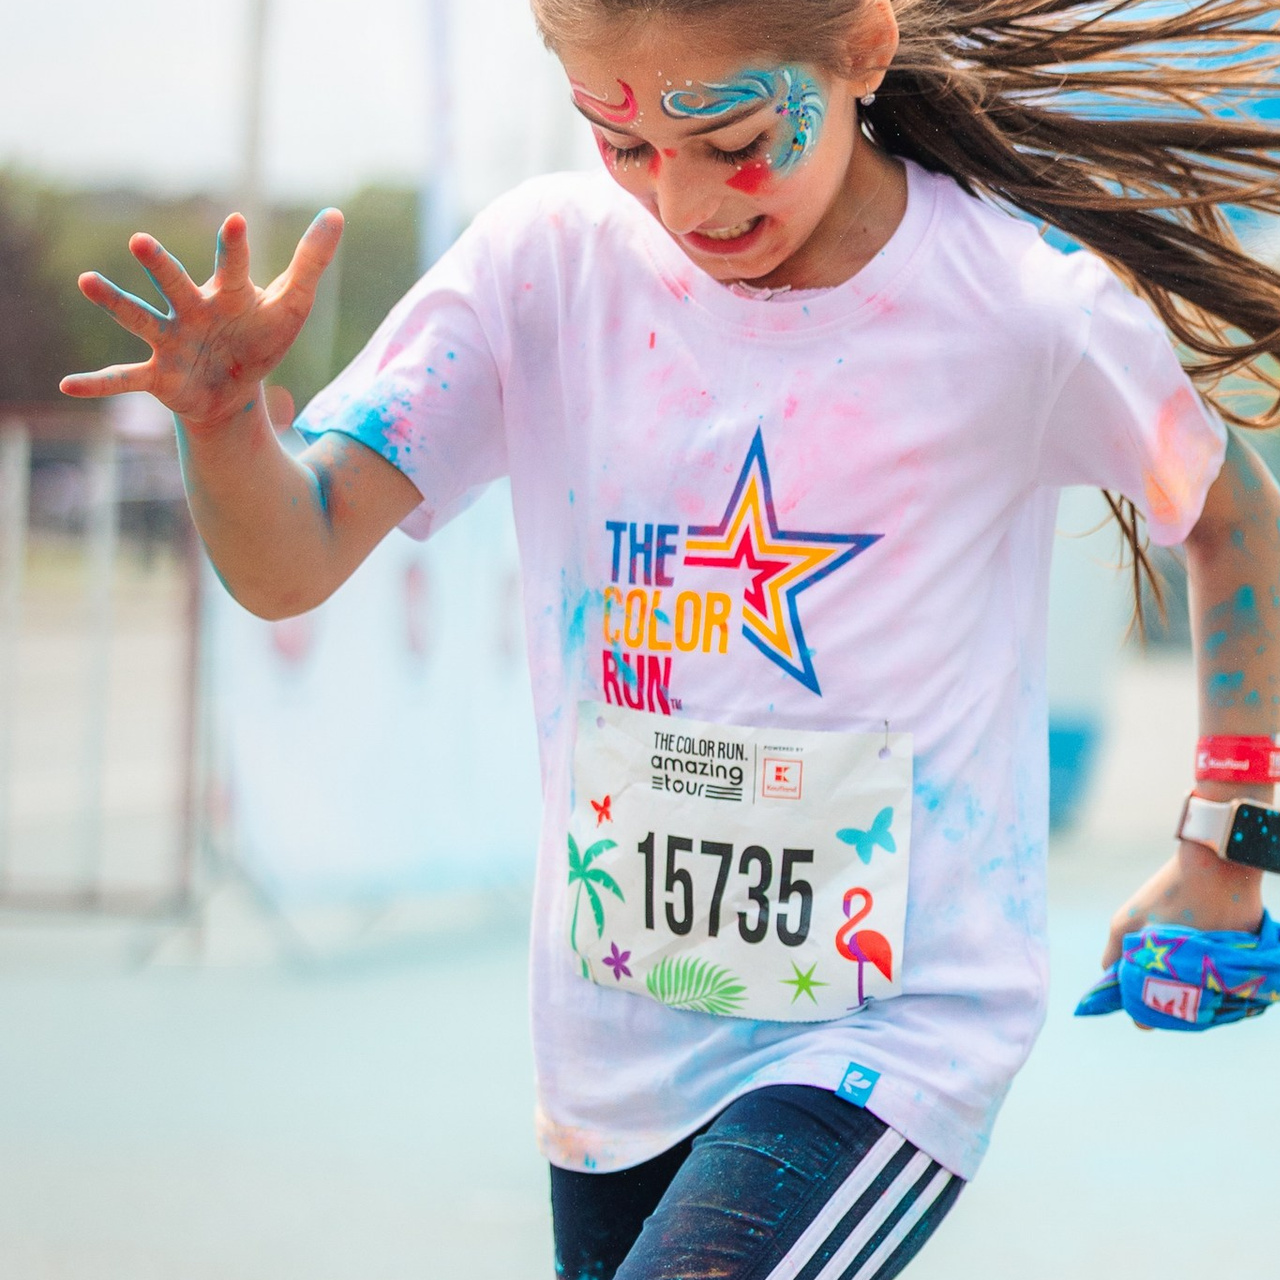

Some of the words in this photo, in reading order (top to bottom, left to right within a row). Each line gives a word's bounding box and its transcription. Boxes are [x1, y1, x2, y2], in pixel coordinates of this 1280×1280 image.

[605, 520, 679, 587] THE
[602, 585, 732, 654] COLOR
[602, 649, 672, 716] RUN
[651, 755, 744, 786] amazing
[654, 731, 675, 752] THE
[676, 735, 715, 758] COLOR
[664, 774, 705, 797] tour
[637, 831, 815, 948] 15735
